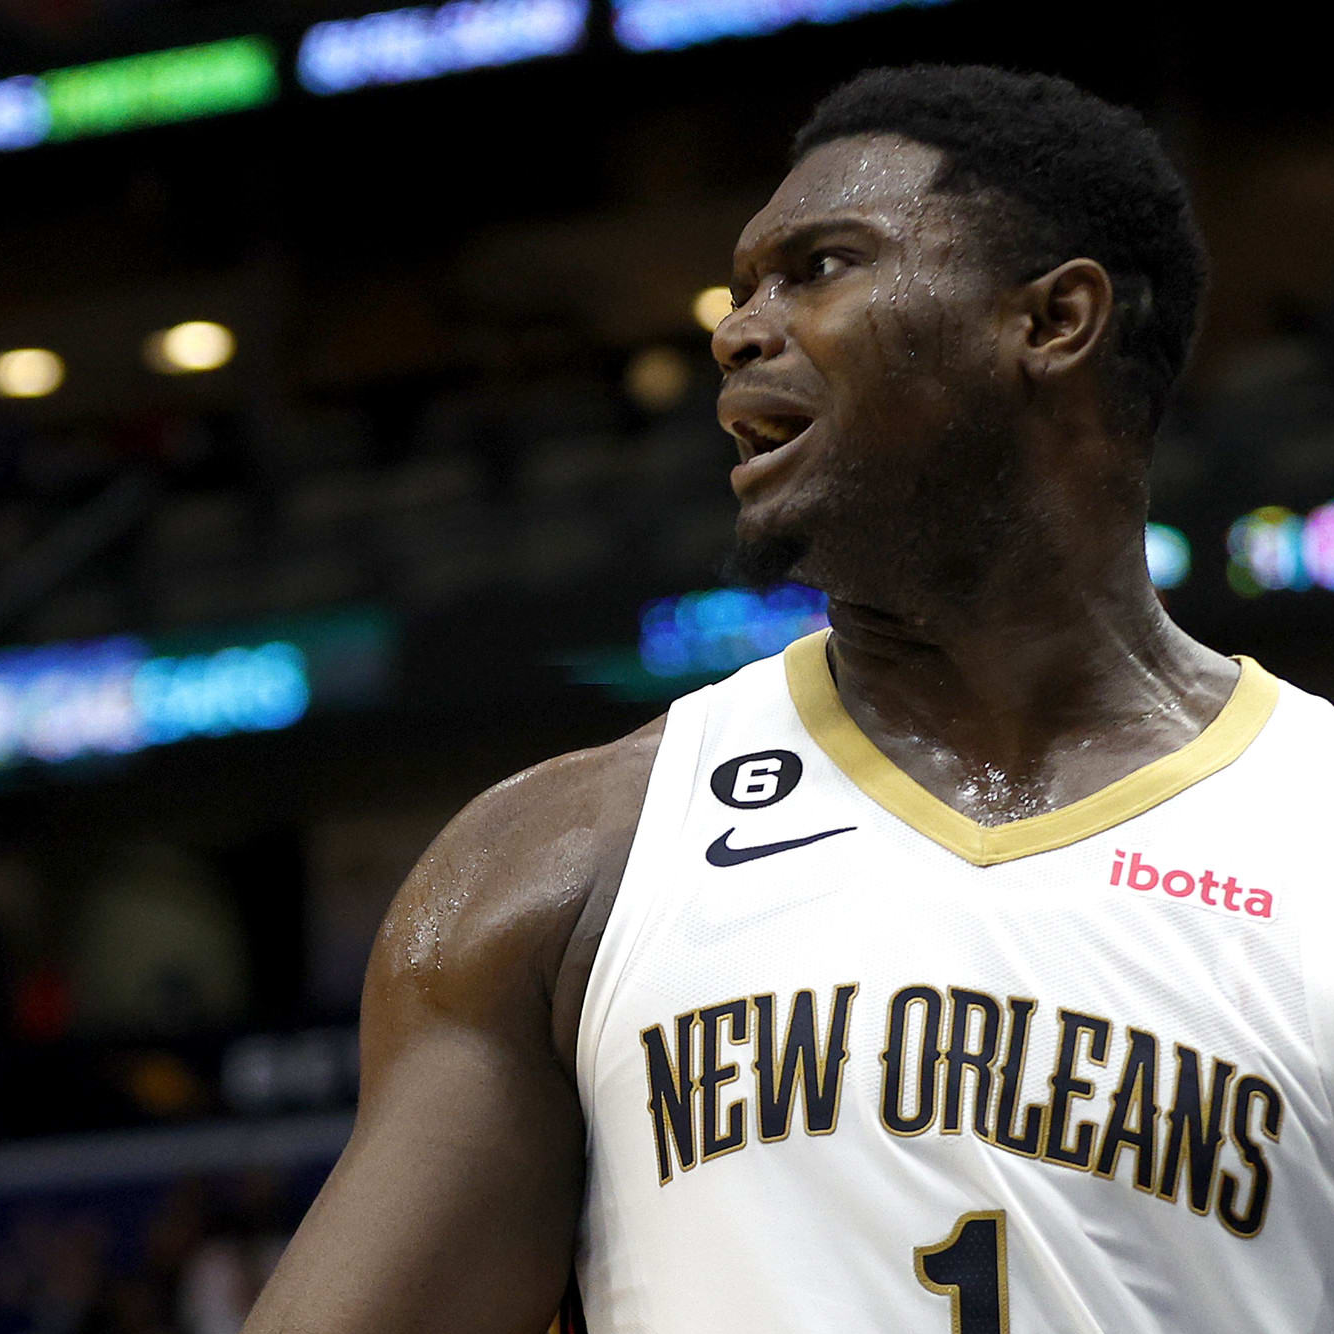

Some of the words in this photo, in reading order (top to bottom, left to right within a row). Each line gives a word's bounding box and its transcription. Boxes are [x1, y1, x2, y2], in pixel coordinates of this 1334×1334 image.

[731, 757, 783, 803] 6
[1109, 848, 1273, 919] ibotta
[640, 983, 859, 1186] NEW
[878, 985, 1284, 1239] ORLEANS
